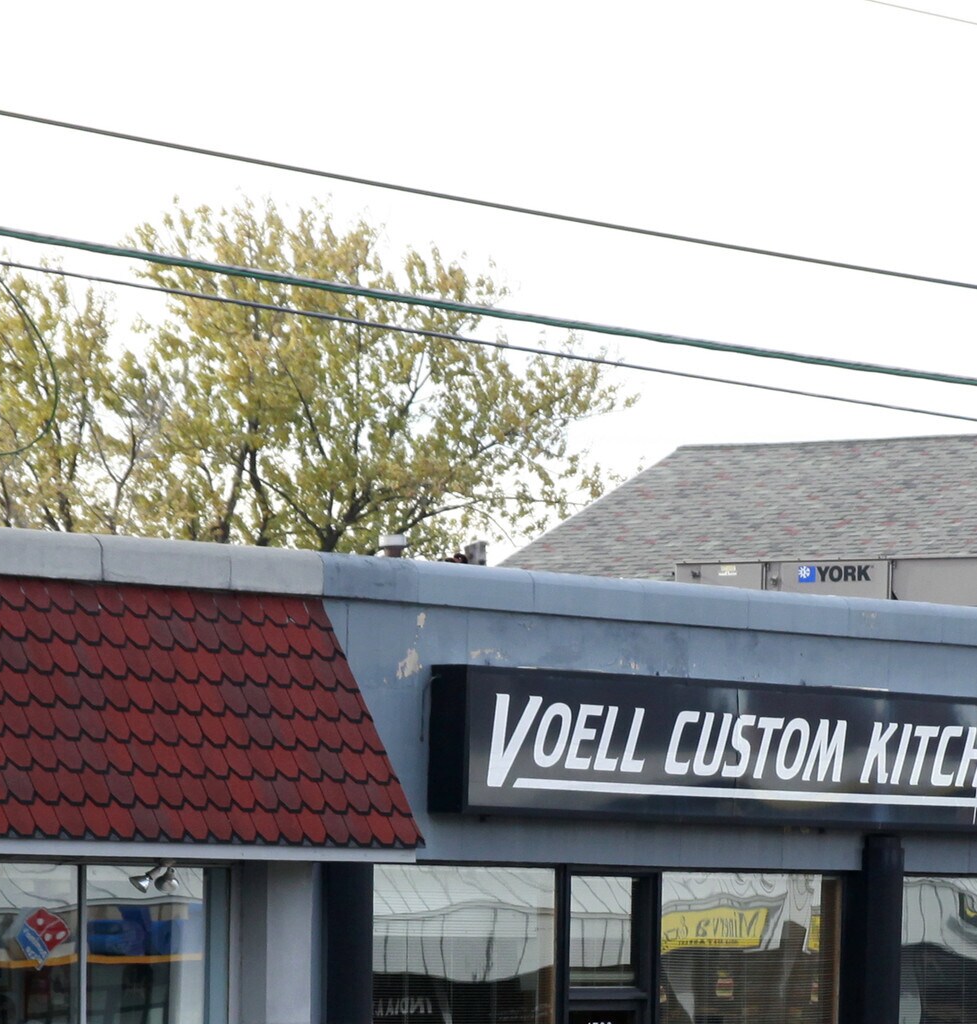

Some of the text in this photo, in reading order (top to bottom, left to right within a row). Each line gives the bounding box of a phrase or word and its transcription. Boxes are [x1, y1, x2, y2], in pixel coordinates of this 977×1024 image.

[817, 565, 871, 582] YORK
[487, 693, 646, 787] VOELL
[664, 710, 848, 782] CUSTOM
